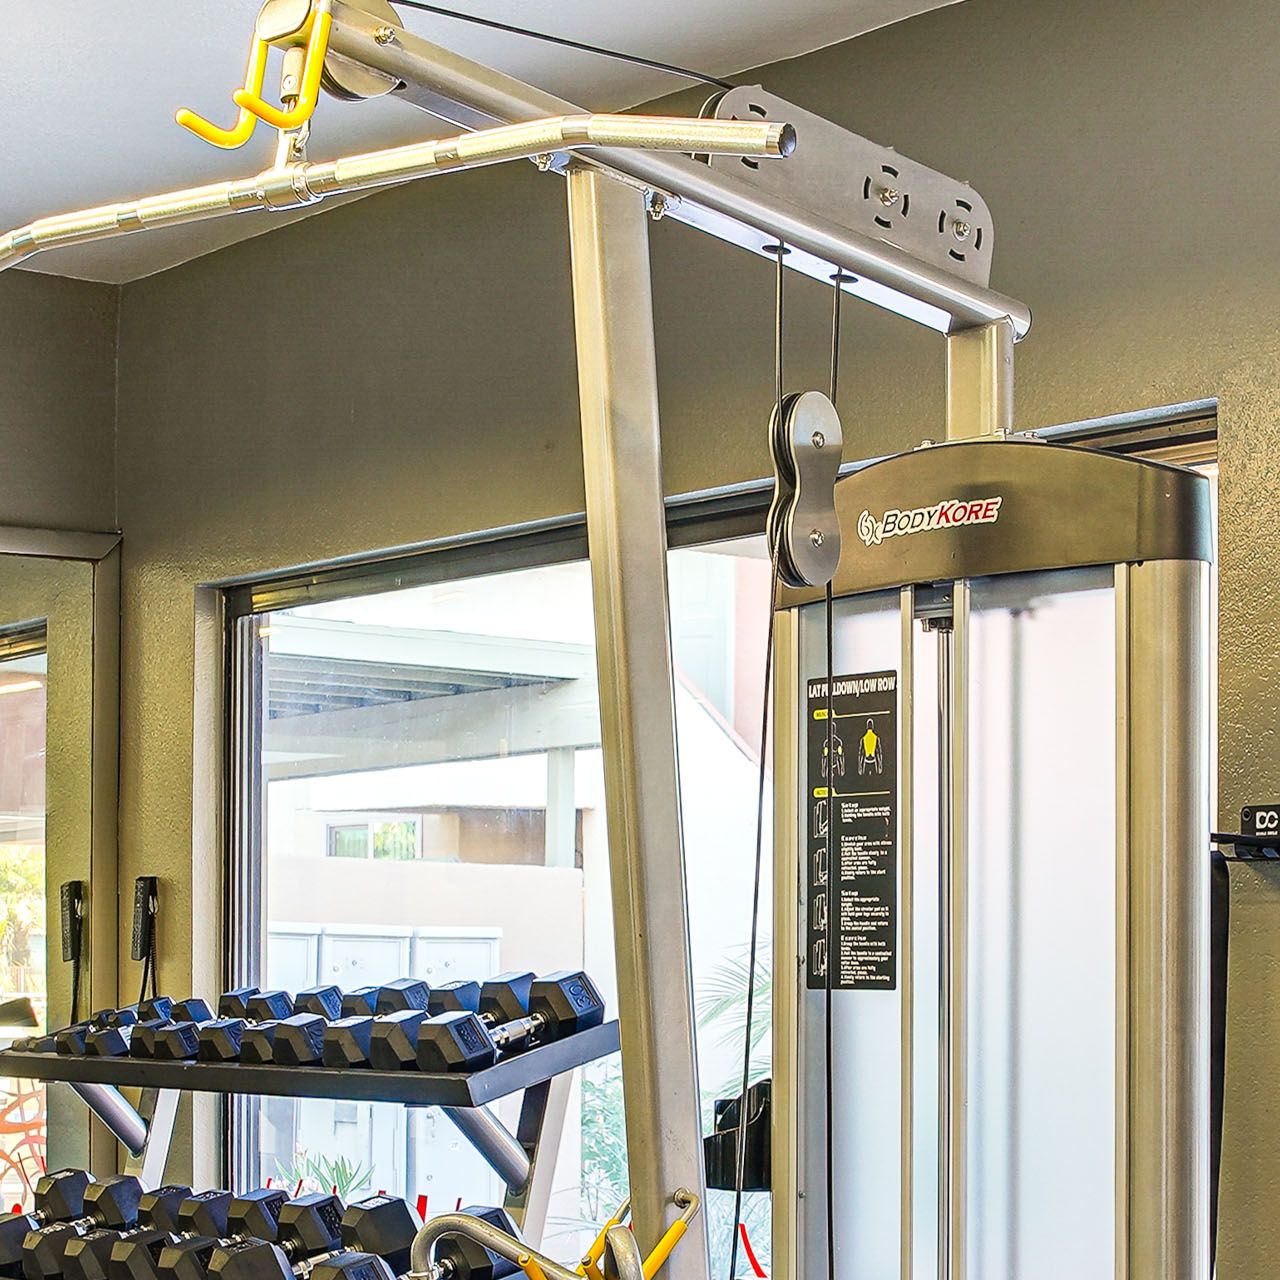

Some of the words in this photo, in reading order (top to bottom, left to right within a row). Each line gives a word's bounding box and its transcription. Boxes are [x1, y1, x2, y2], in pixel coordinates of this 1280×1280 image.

[881, 500, 1000, 535] BODYKORE
[808, 684, 821, 698] LAT
[877, 677, 896, 691] ROW
